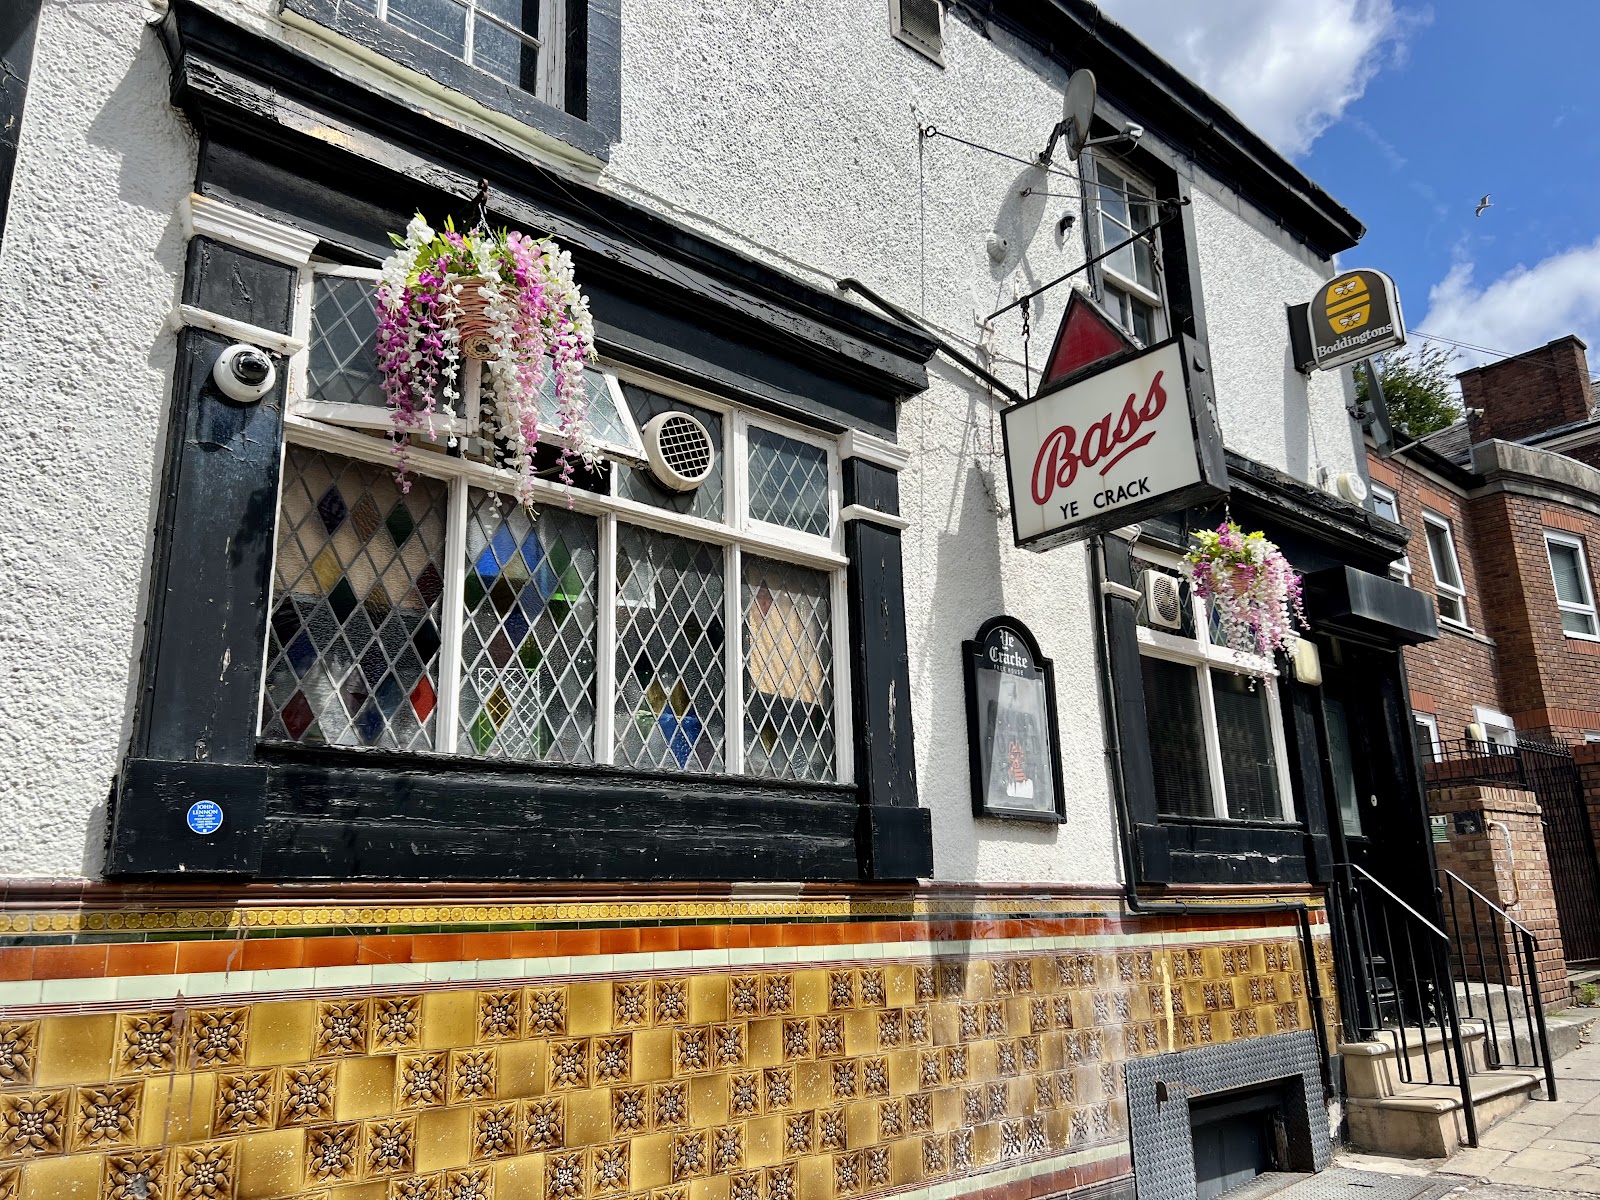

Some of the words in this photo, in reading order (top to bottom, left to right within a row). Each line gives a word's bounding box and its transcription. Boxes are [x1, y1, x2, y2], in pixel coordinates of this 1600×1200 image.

[1316, 323, 1393, 358] Boddingtons
[1031, 370, 1167, 506] Bass
[1060, 501, 1079, 520] YE
[1093, 477, 1151, 509] CRACK
[989, 646, 1028, 669] Cracke
[999, 629, 1014, 652] Ye
